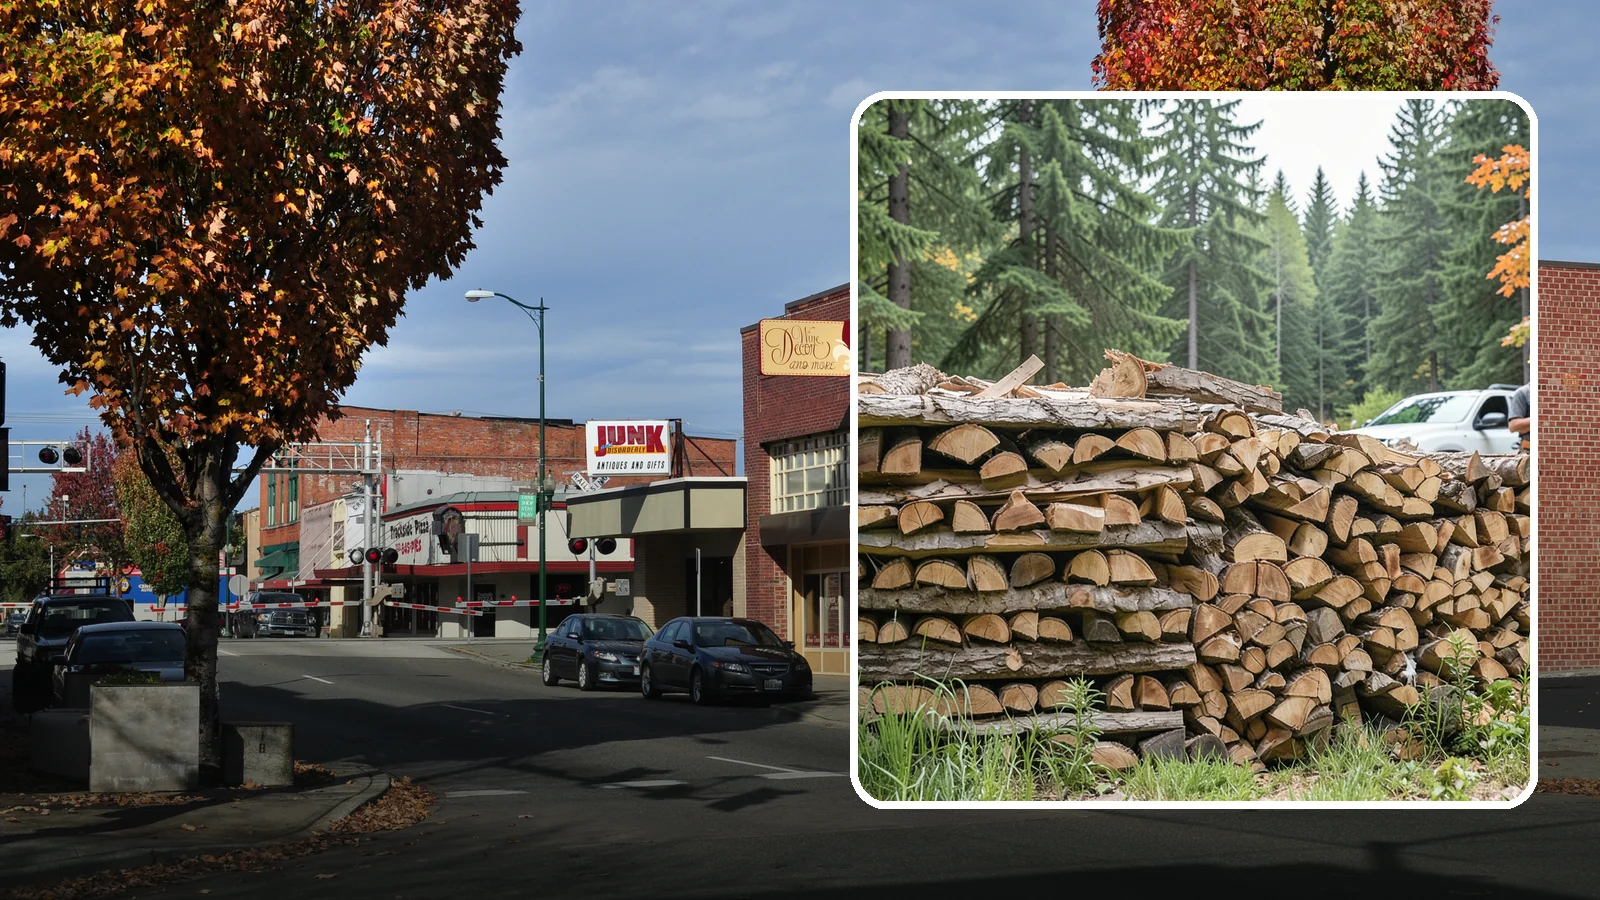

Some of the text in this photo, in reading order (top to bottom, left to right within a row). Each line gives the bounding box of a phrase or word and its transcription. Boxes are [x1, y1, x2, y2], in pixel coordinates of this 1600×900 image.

[595, 425, 665, 457] JUNK
[607, 446, 646, 454] DISORDERLY
[596, 461, 665, 470] ANTIQUES AND GIFTS
[390, 519, 429, 539] Trackside Pizza
